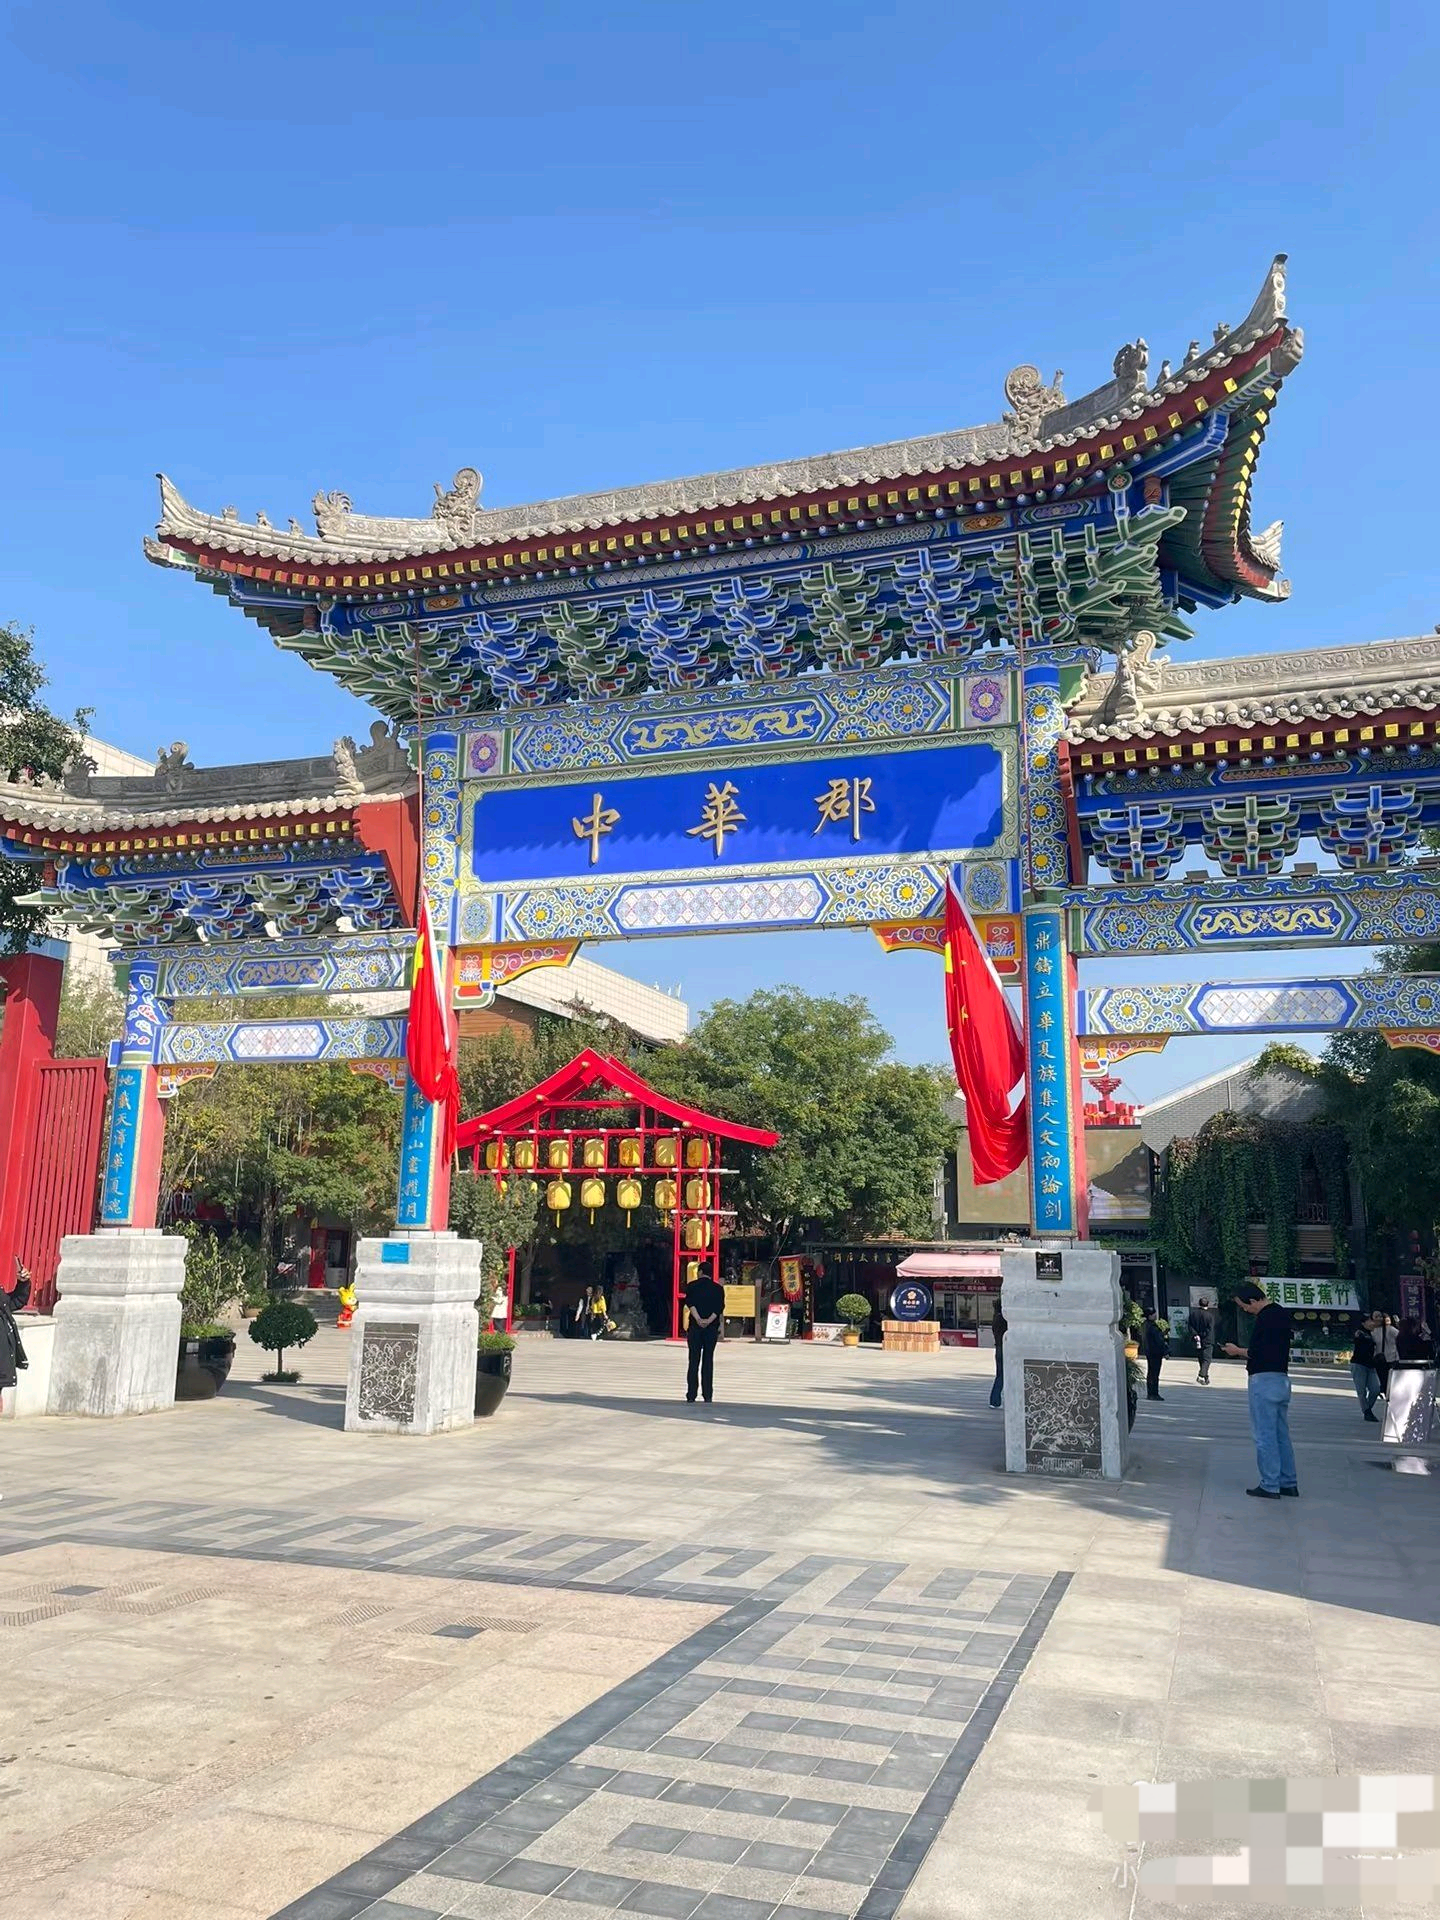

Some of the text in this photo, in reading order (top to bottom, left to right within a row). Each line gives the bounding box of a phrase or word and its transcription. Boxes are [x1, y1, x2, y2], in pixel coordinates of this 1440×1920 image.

[1266, 1281, 1350, 1306] 泰国香蕉竹
